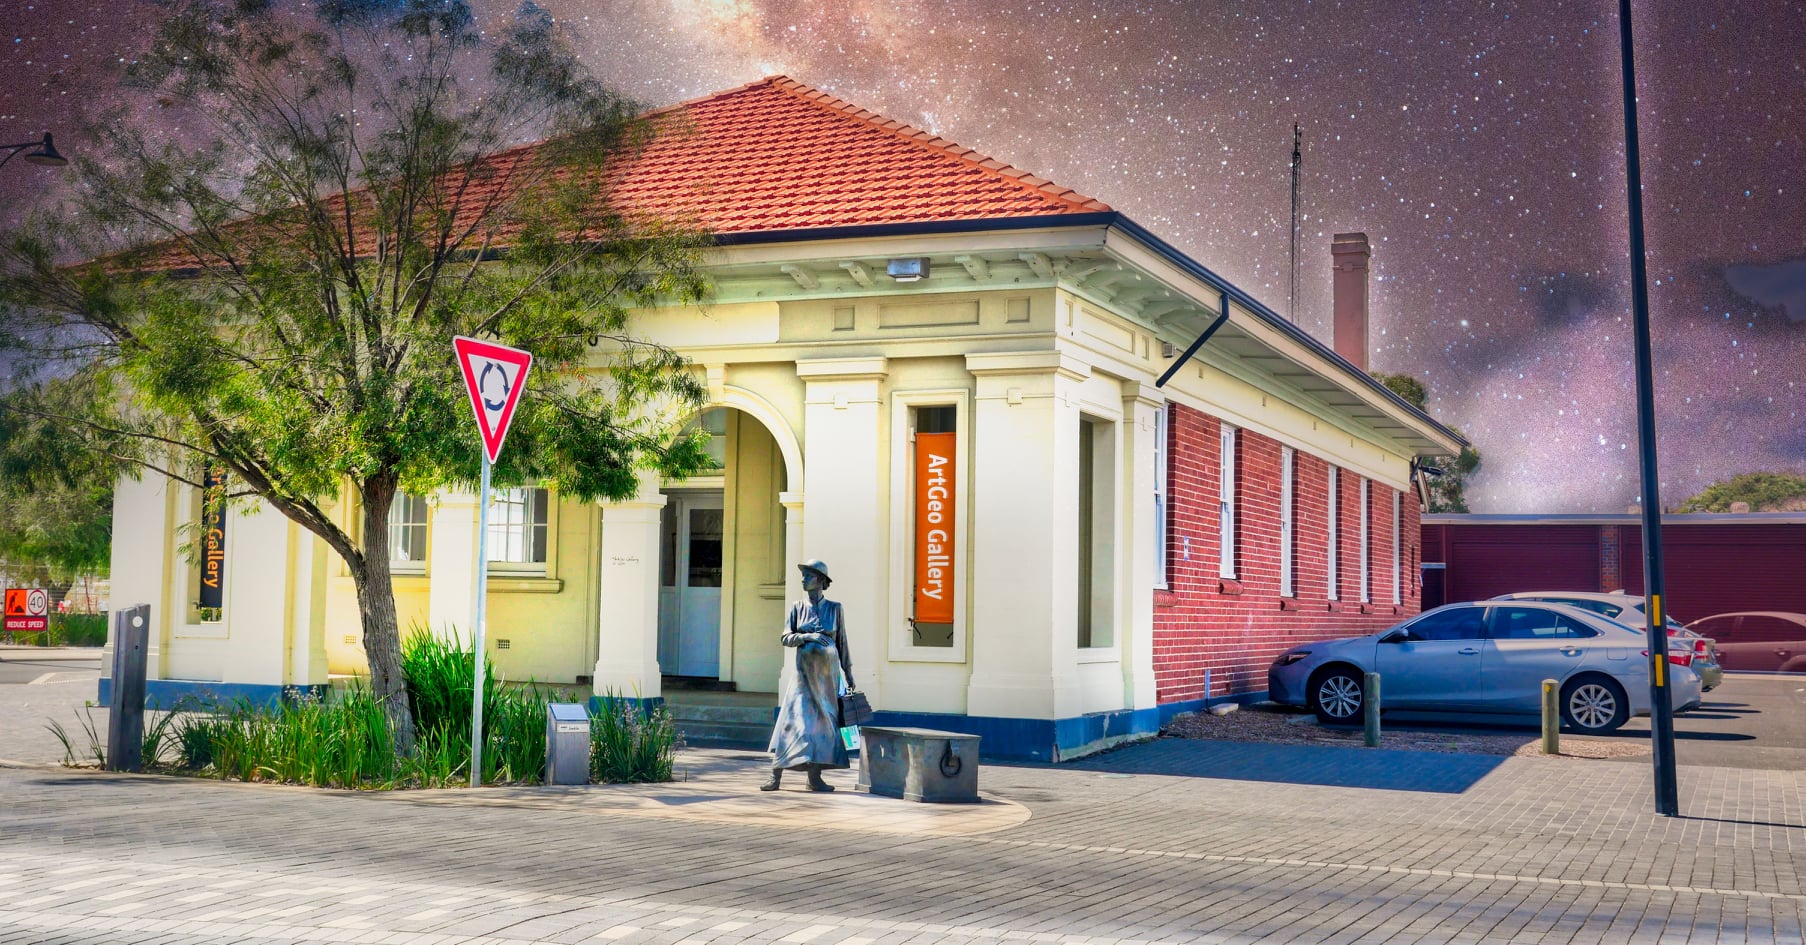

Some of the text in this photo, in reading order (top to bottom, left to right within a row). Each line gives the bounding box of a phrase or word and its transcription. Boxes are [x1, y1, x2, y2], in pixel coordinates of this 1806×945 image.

[203, 465, 227, 588] Arto Gallery
[922, 453, 950, 600] ArtGeo Gallery
[6, 620, 44, 628] REDUCE SPEED
[30, 596, 44, 608] 40
